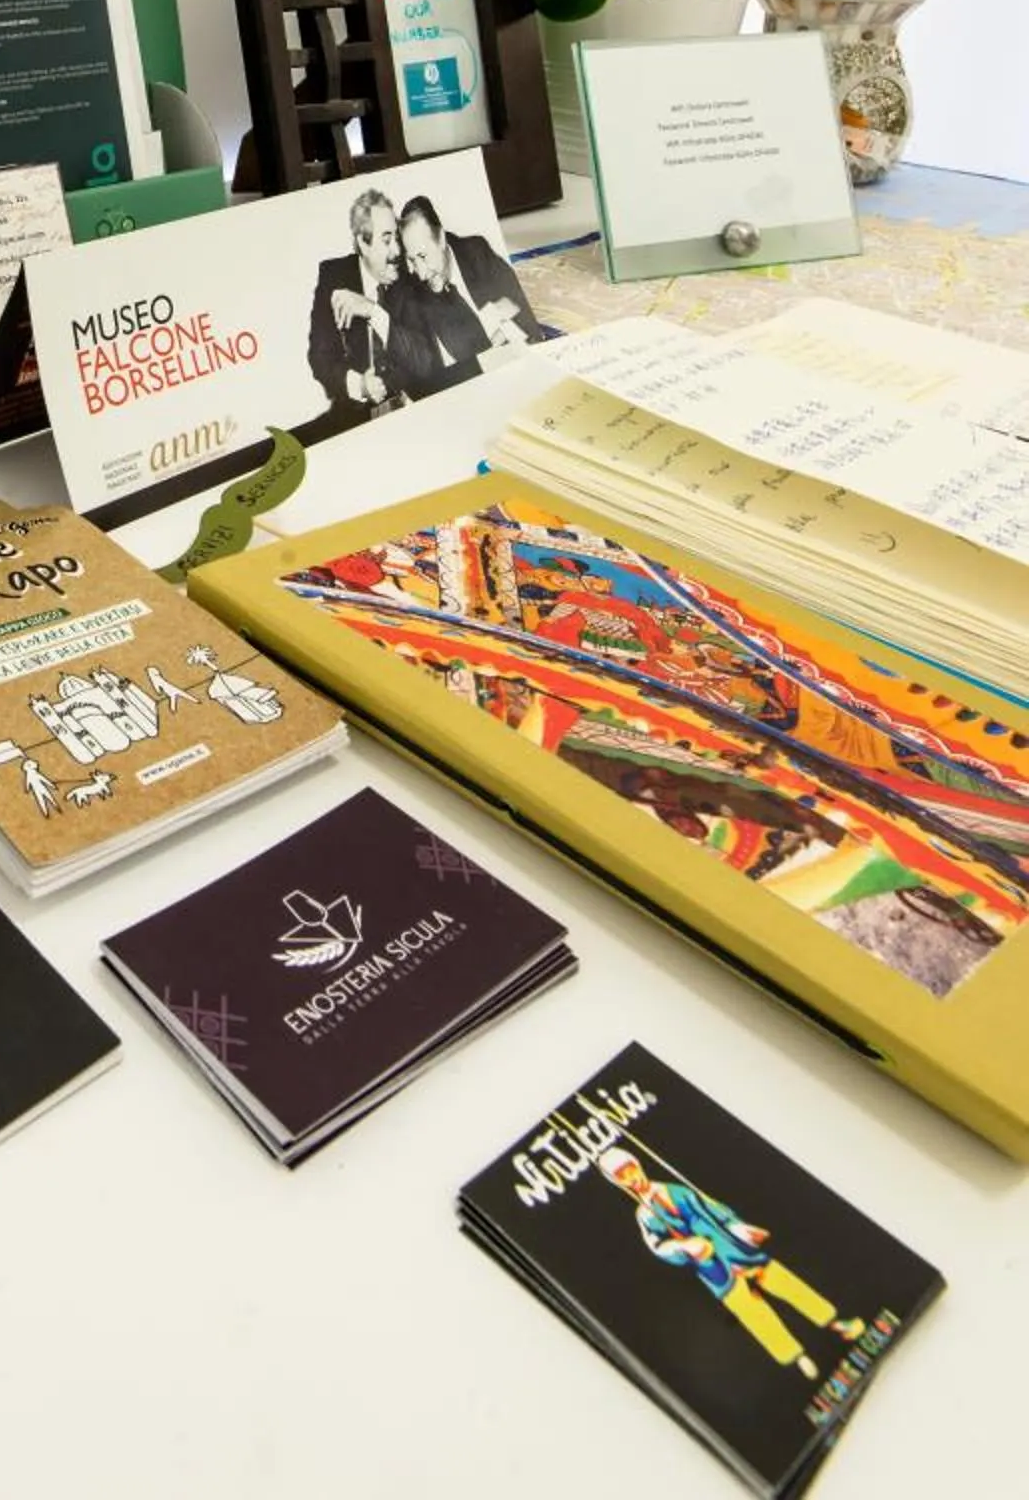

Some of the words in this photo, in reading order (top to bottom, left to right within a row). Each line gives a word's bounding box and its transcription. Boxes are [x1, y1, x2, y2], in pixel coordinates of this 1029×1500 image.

[71, 294, 175, 349] MUSEO
[76, 312, 214, 383] FALCONE
[82, 331, 259, 415] BORSELLINO
[149, 419, 224, 473] anm
[283, 953, 395, 1035] ENOSTERIA
[384, 910, 455, 961] SICULA
